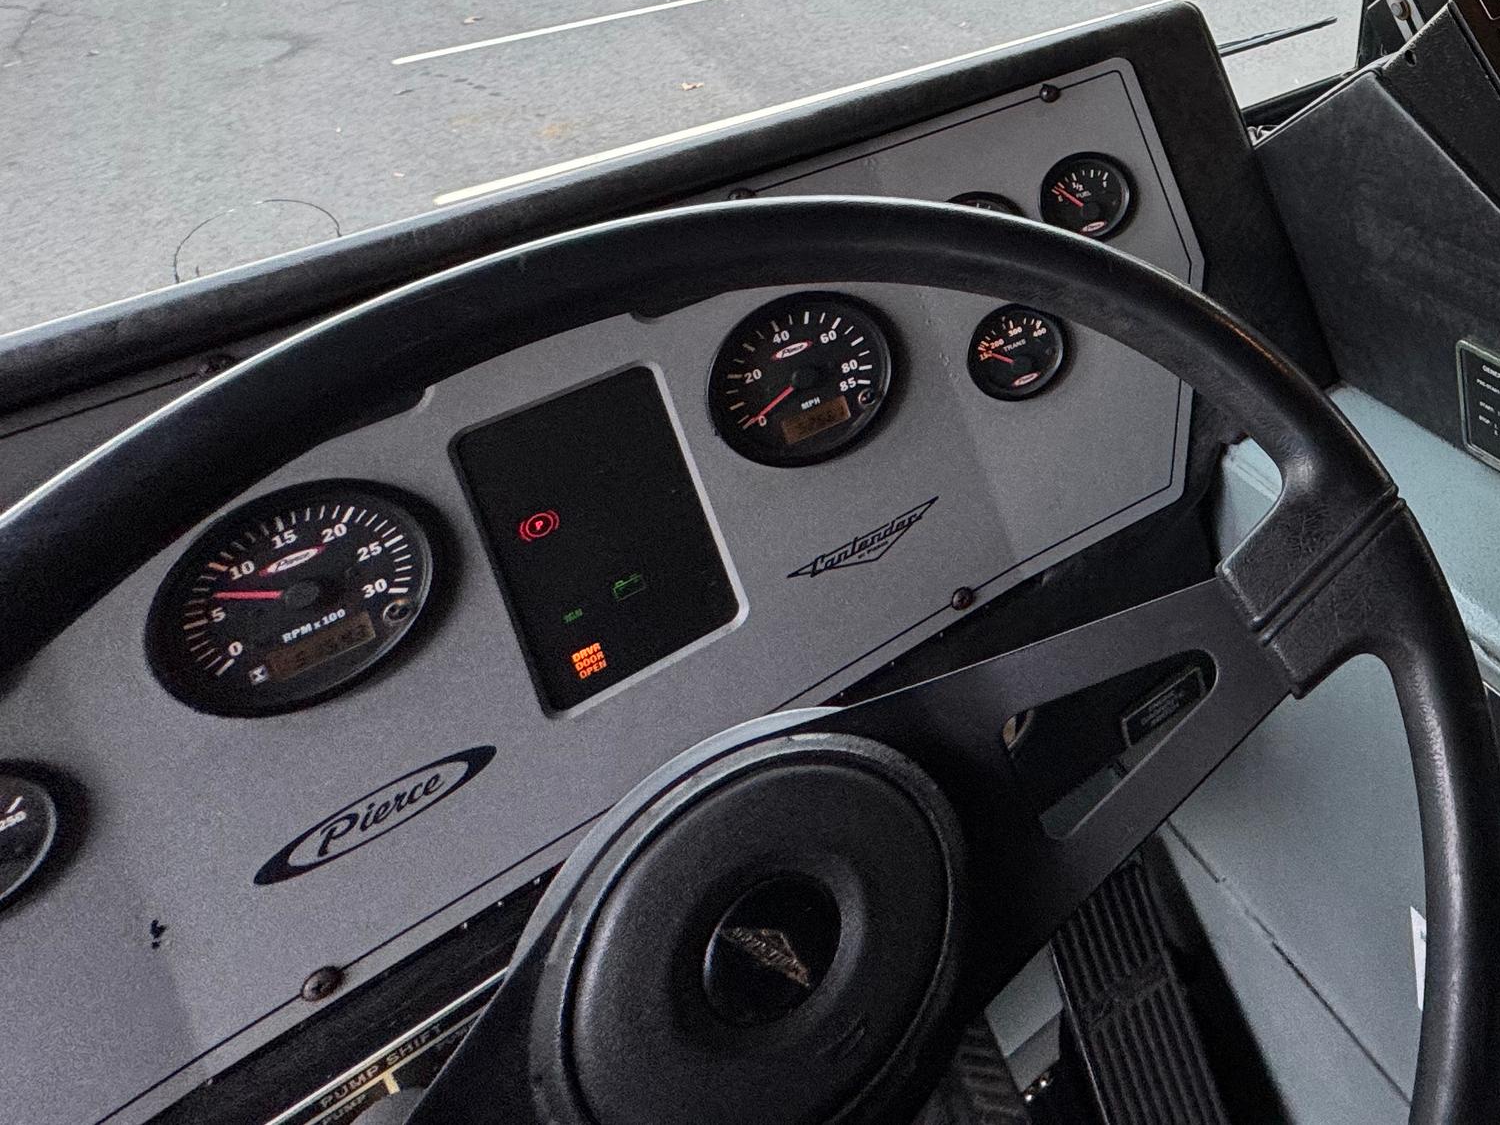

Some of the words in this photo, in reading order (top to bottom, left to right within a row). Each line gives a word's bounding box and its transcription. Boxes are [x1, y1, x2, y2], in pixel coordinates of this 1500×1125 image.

[1076, 190, 1092, 198] FUEL
[772, 330, 790, 344] 40
[819, 330, 837, 344] 60
[1003, 338, 1026, 352] TRANS
[841, 359, 858, 373] 80
[744, 369, 762, 383] 20
[839, 377, 857, 391] 85
[801, 396, 820, 410] MPH
[757, 415, 767, 427] 0
[272, 529, 298, 549] 15
[321, 523, 348, 543] 20
[356, 542, 383, 562] 25
[229, 560, 255, 581] 10
[362, 578, 388, 599] 30
[211, 607, 226, 623] 5
[282, 622, 313, 644] RPM
[322, 609, 346, 626] 100
[228, 641, 243, 657] 0
[572, 642, 601, 663] DRVR
[575, 650, 604, 672] DOOR
[579, 659, 607, 679] OPEN
[317, 771, 445, 858] Pierce
[320, 1065, 379, 1108] PUMP
[386, 1024, 442, 1066] SHIFT
